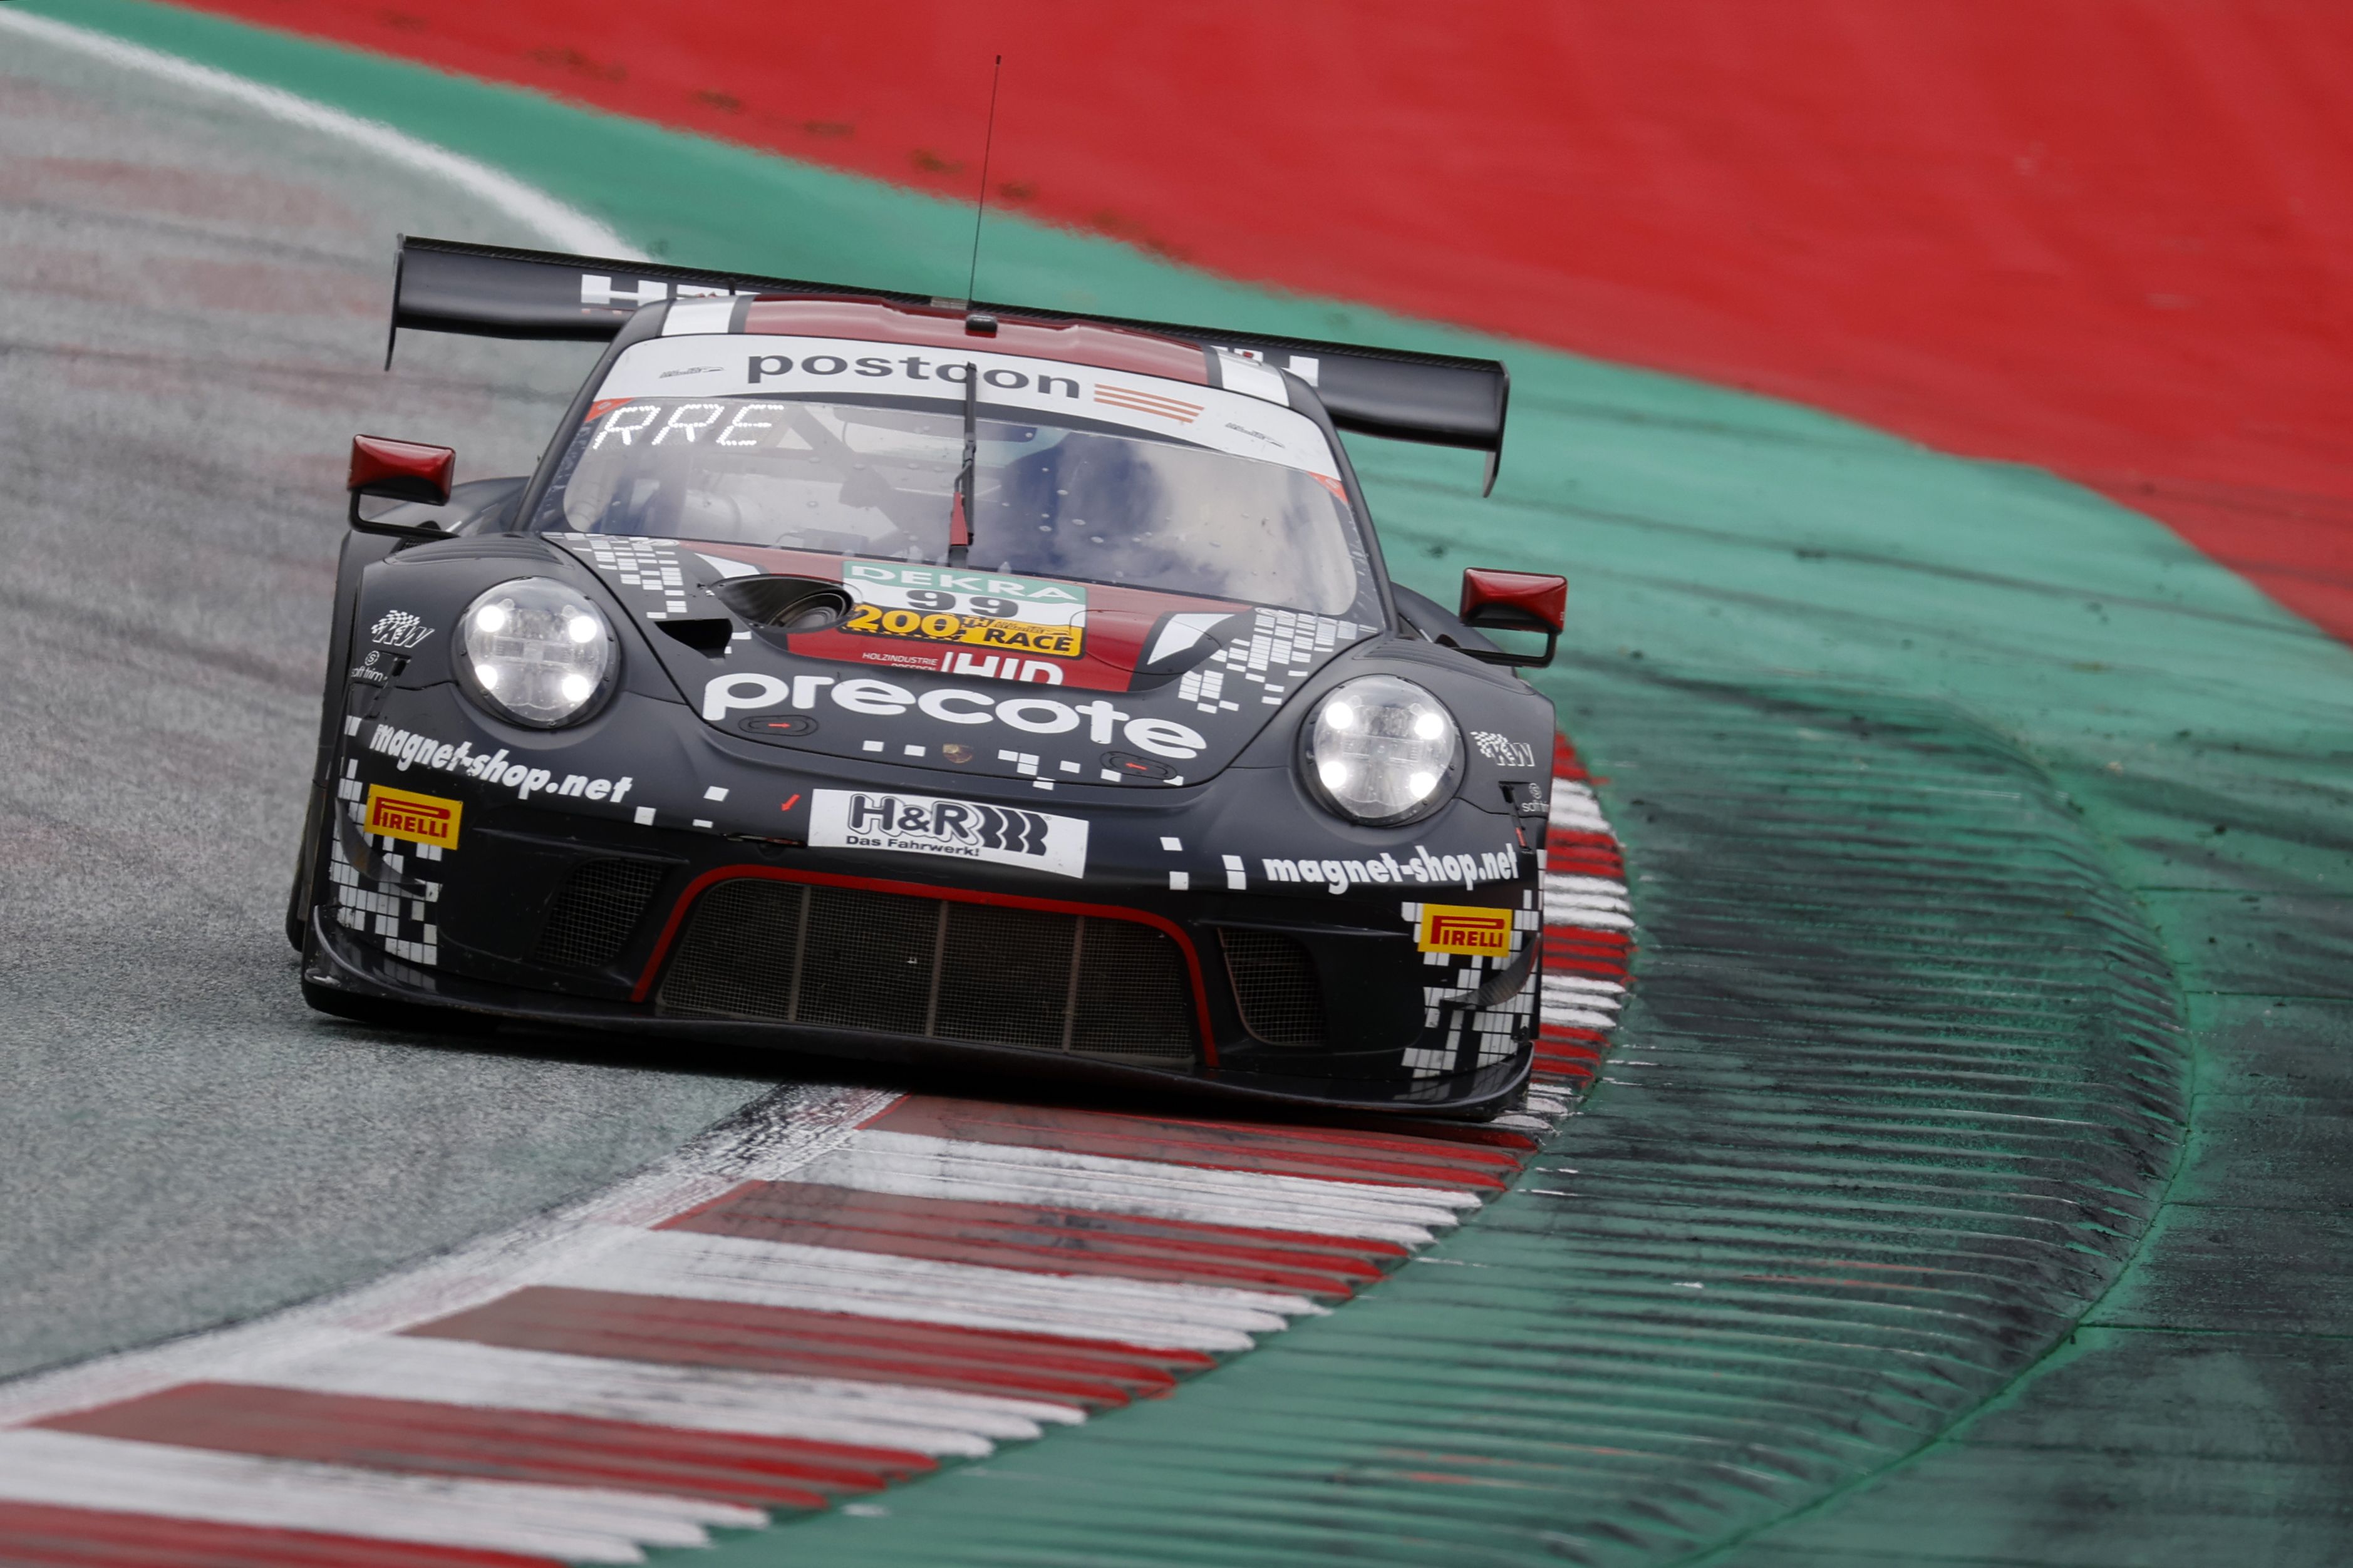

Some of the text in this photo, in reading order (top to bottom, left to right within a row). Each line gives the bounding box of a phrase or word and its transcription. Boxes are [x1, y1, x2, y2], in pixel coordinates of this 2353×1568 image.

[592, 403, 785, 450] RRE
[851, 565, 1079, 601] DEKRA
[906, 589, 1018, 618] 99
[862, 652, 938, 666] HOLZINDUSTRIE
[983, 628, 1074, 652] RACE
[703, 673, 1207, 759] precote
[370, 723, 633, 802] magnet-shop.net
[373, 796, 451, 838] PIRELLI
[849, 794, 979, 843] H&R
[846, 835, 980, 857] Das Fahrwerk!
[1262, 842, 1519, 895] magnet-shop.net
[1430, 915, 1506, 948] PIRELLI
